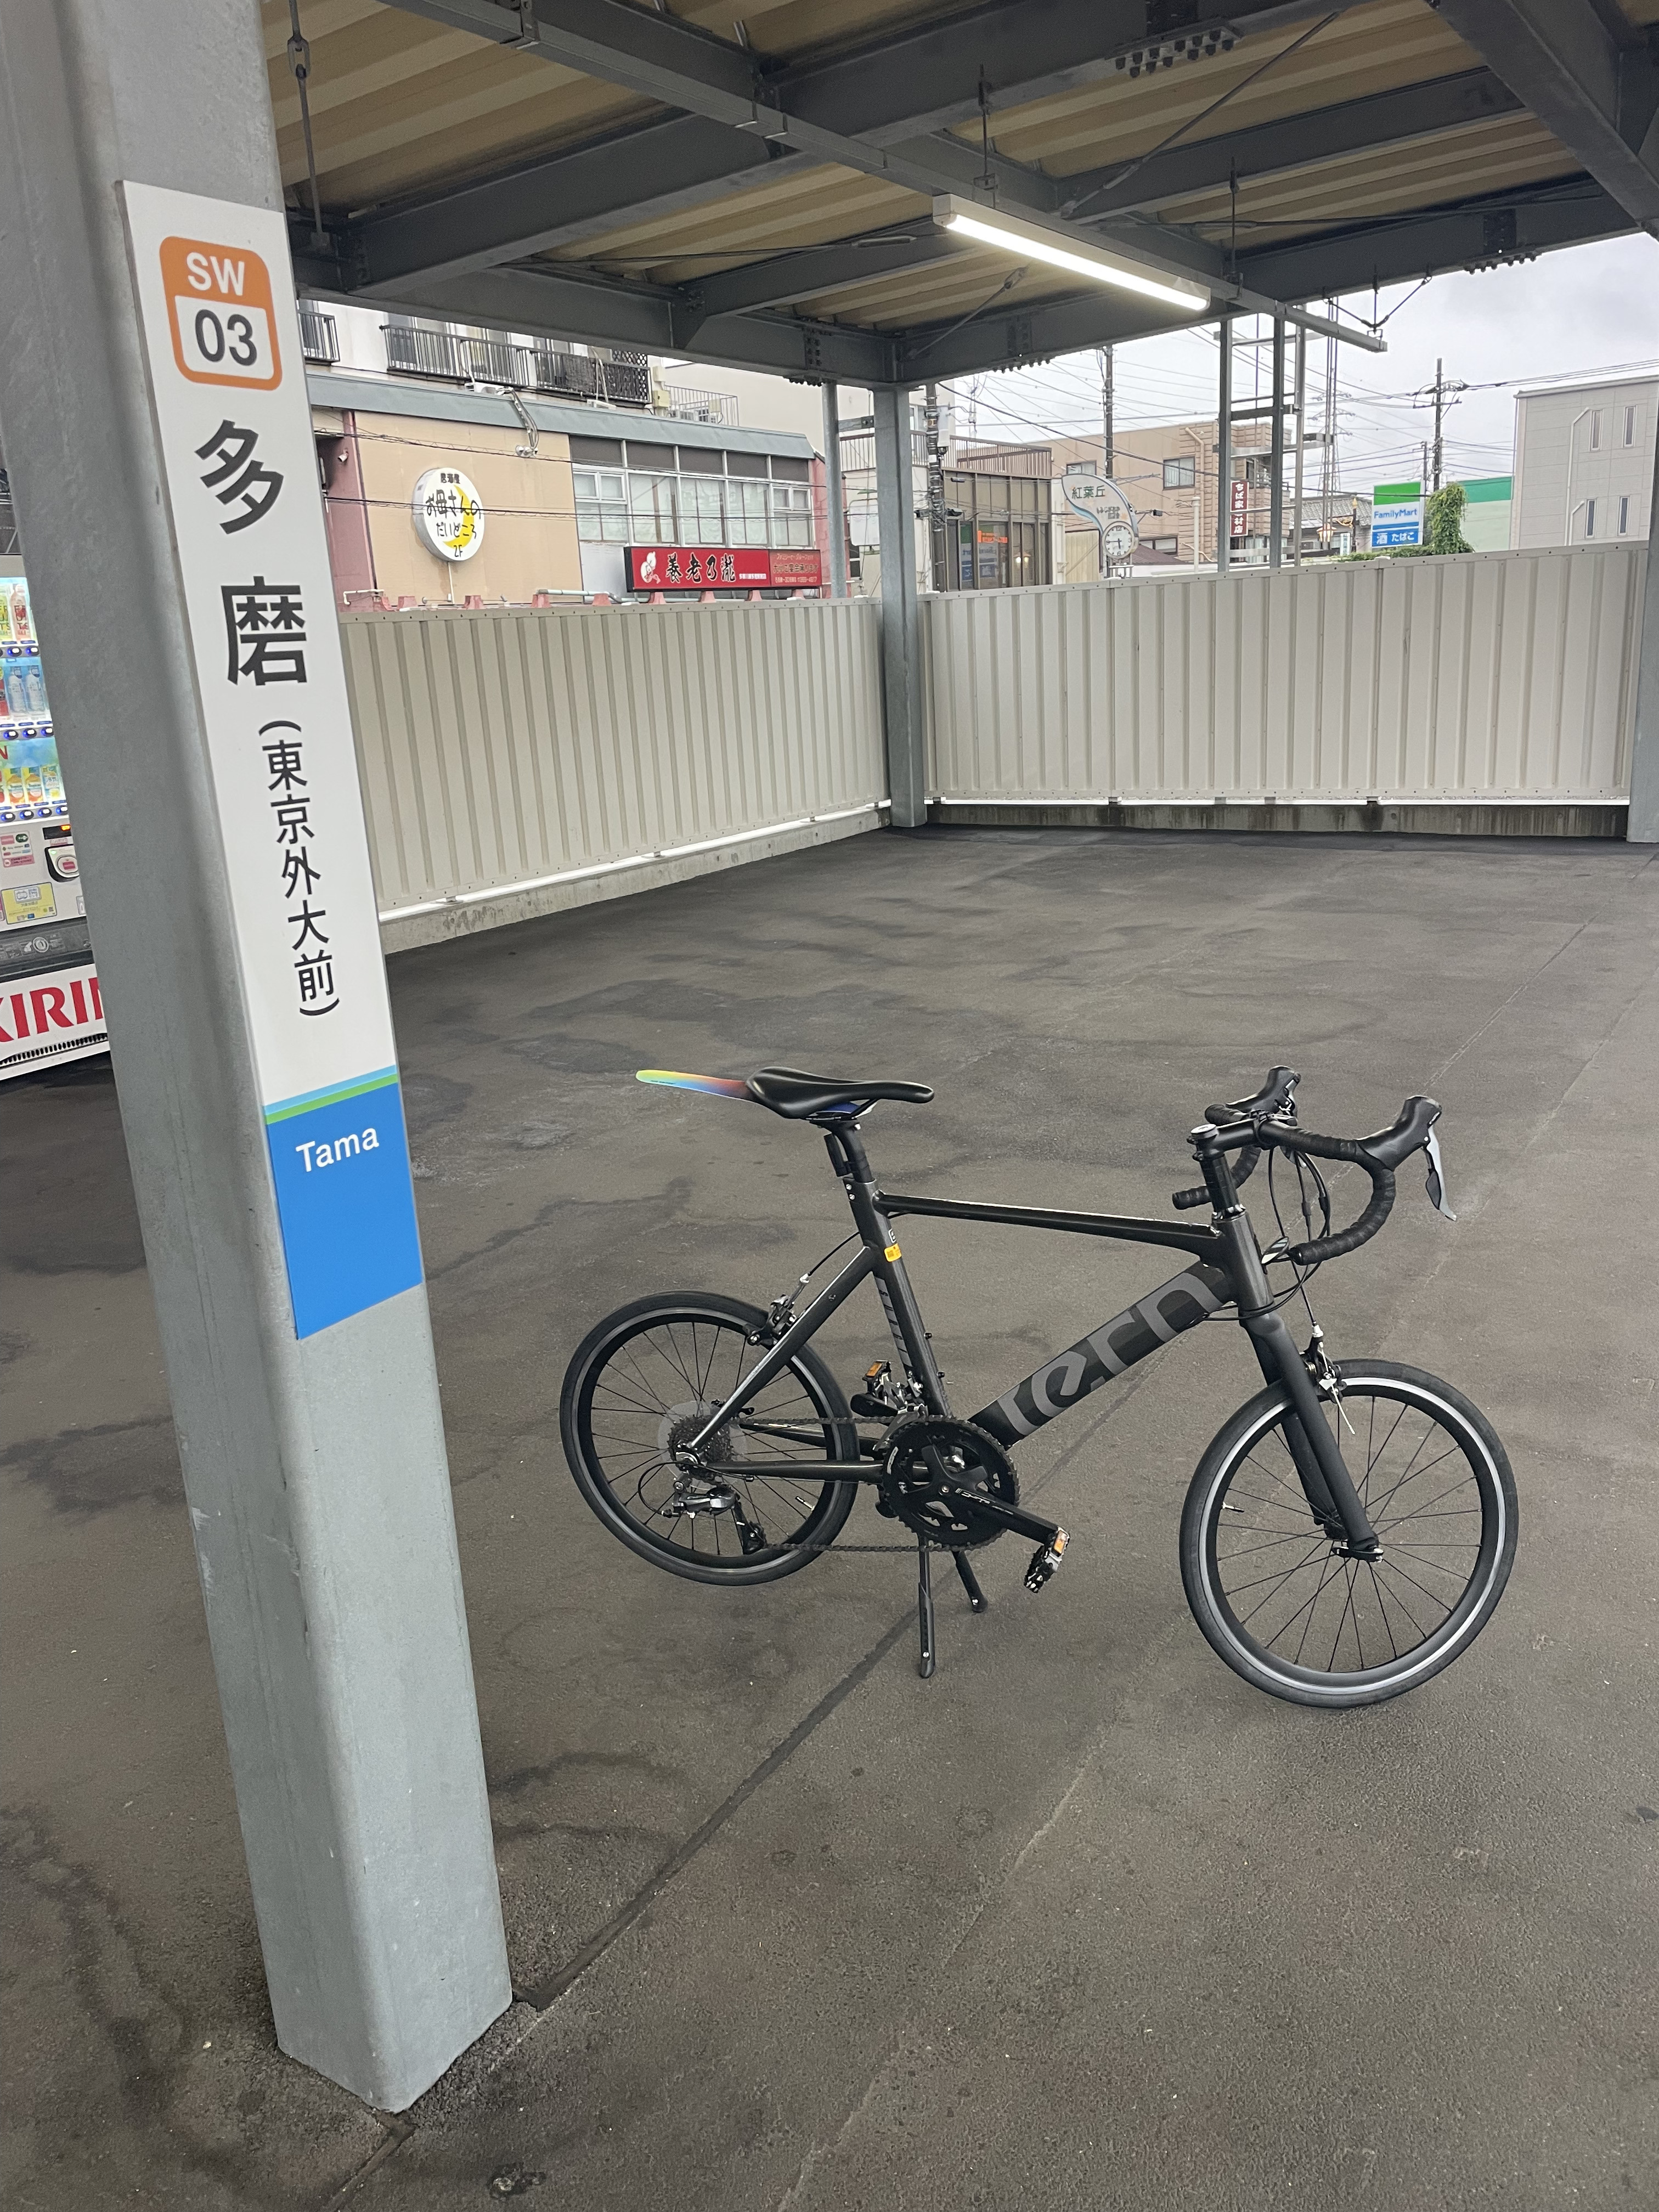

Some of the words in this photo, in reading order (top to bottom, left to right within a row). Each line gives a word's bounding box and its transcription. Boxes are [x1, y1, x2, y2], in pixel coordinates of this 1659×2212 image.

[187, 252, 246, 296] SW
[194, 308, 258, 366] 03
[1071, 484, 1106, 499] 紅葉丘
[1374, 509, 1417, 519] FamilyMart
[454, 544, 463, 557] 2F
[1376, 532, 1388, 544] 酒
[1392, 532, 1414, 542] たばこ
[194, 419, 308, 687] 多磨
[258, 719, 340, 1018] (東京外大前)
[295, 1125, 380, 1173] Tama
